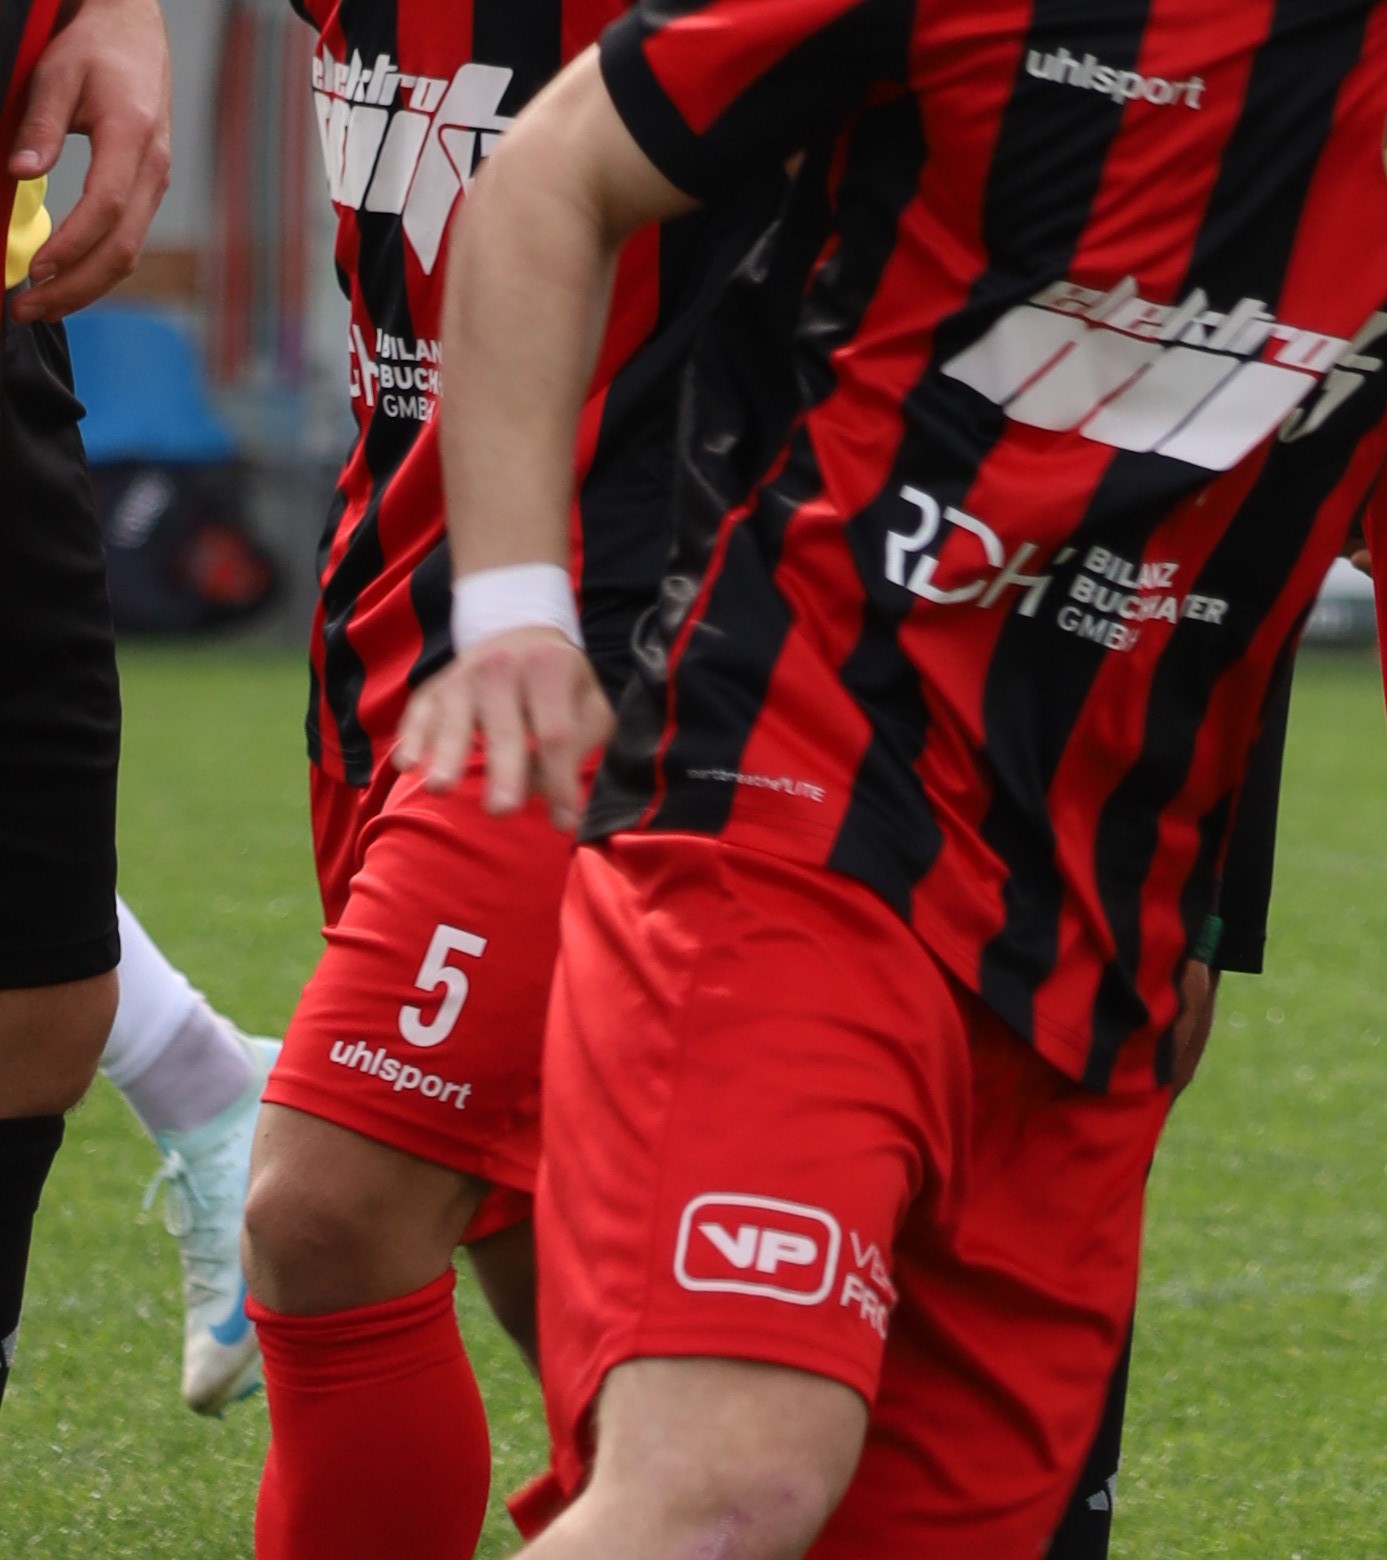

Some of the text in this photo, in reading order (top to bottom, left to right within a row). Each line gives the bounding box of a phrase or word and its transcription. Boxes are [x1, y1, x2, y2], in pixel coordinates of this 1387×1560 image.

[1025, 46, 1207, 111] uhlsport
[381, 333, 442, 365] BILAN
[397, 923, 489, 1048] 5
[328, 1038, 473, 1110] uhlsport
[697, 1221, 818, 1274] VP
